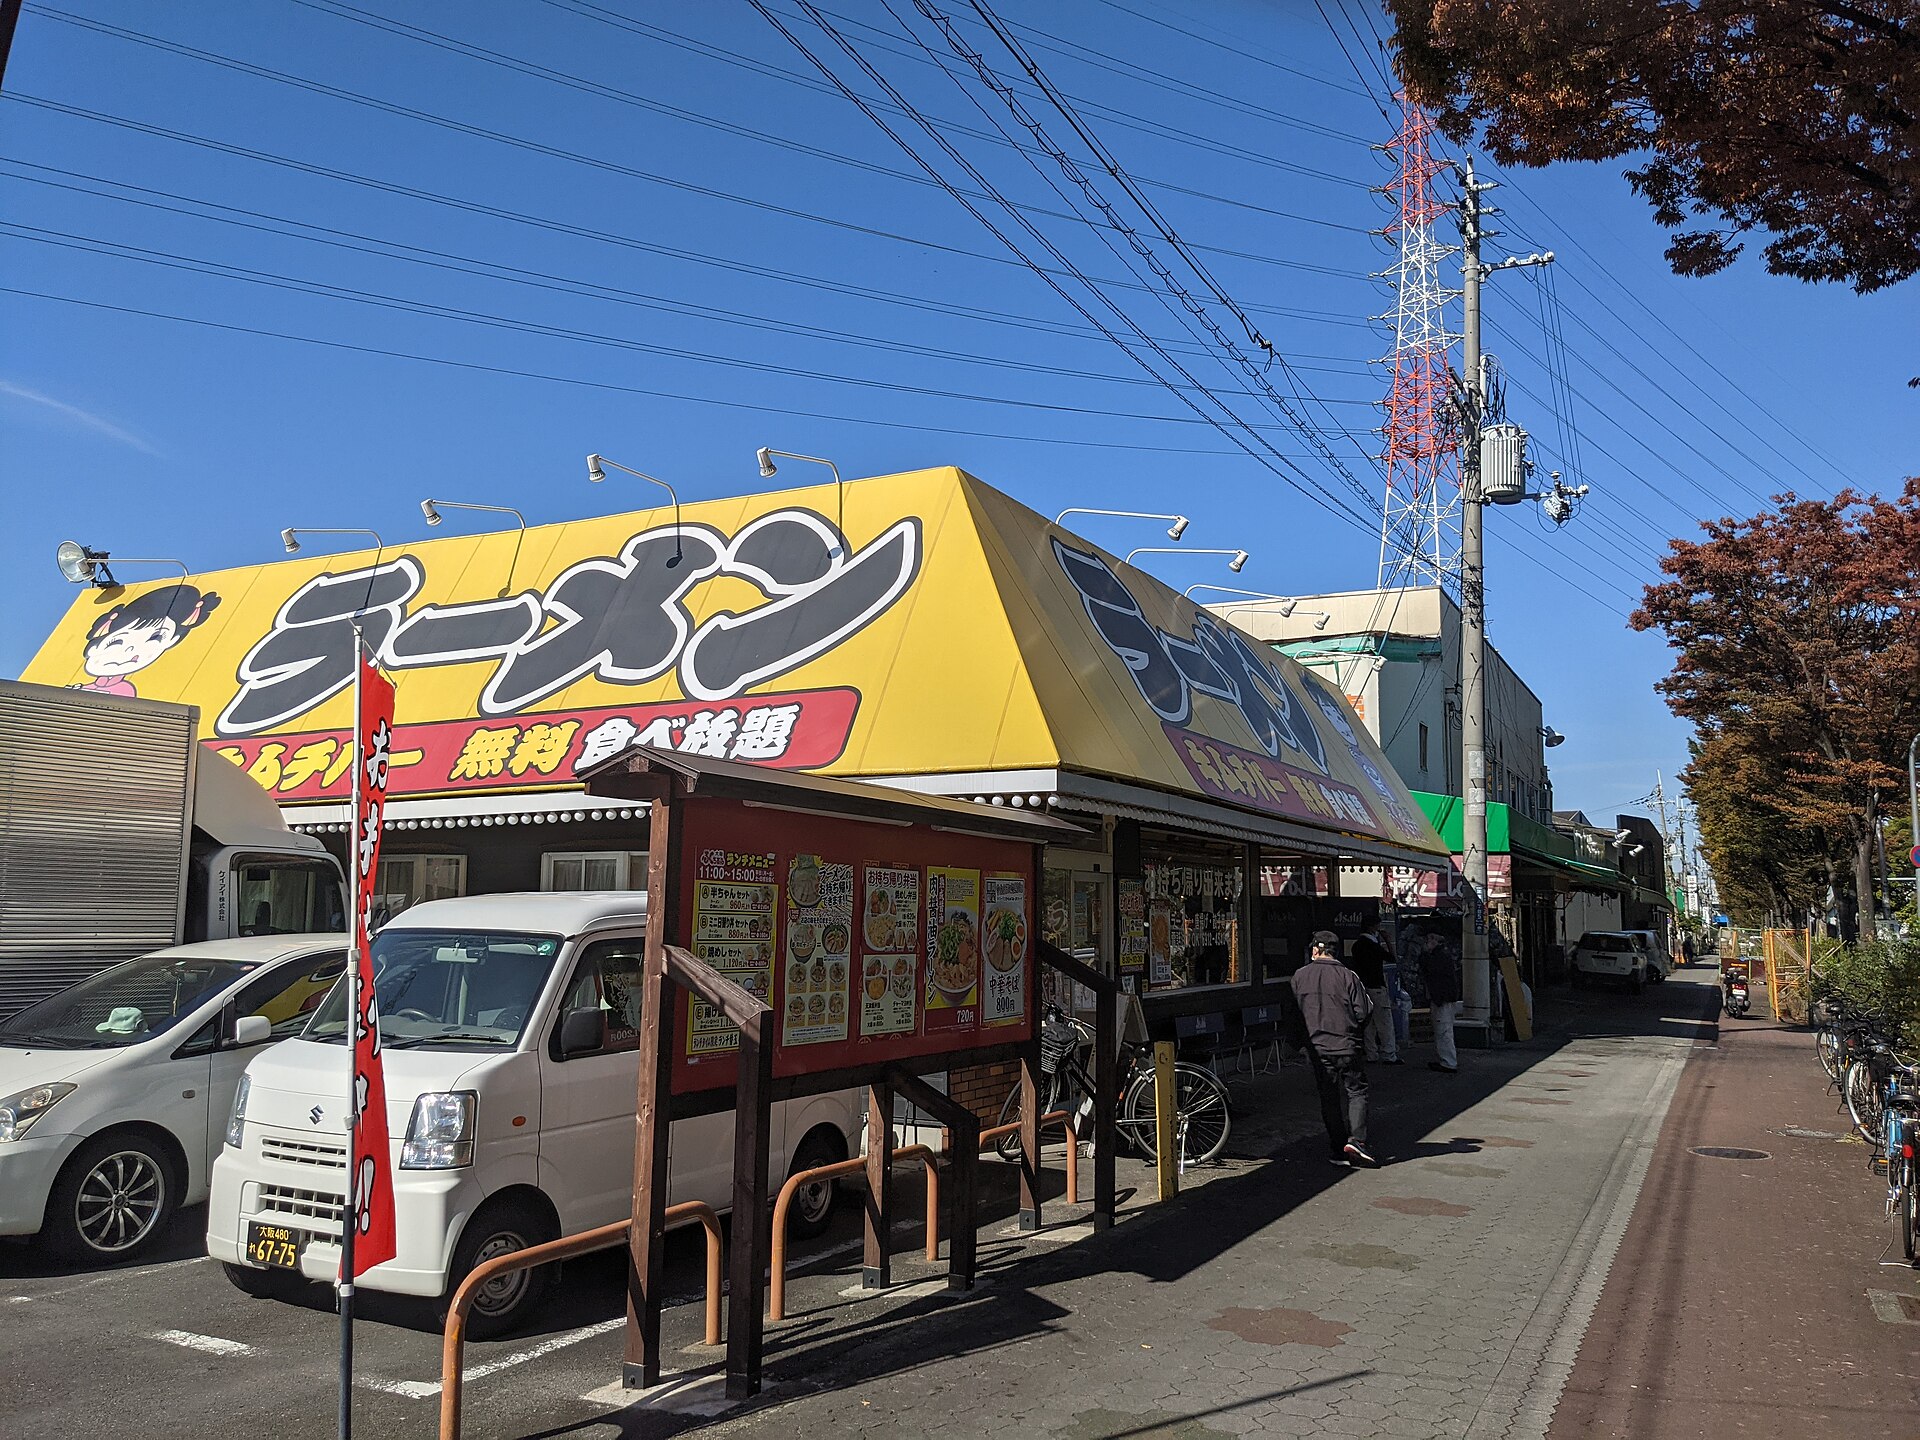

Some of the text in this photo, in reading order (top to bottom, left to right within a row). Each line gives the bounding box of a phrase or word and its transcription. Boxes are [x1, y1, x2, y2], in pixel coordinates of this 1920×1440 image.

[214, 506, 922, 737] ラーメン
[1051, 536, 1329, 777] ラーメン
[725, 852, 775, 869] ランチメニュー
[868, 870, 917, 889] お持ち帰り弁当
[710, 887, 750, 900] 半ちゃんセット
[990, 973, 1020, 997] 中華そば
[996, 995, 1015, 1013] 800円
[957, 1009, 974, 1024] 720円
[257, 1239, 297, 1267] 67-75
